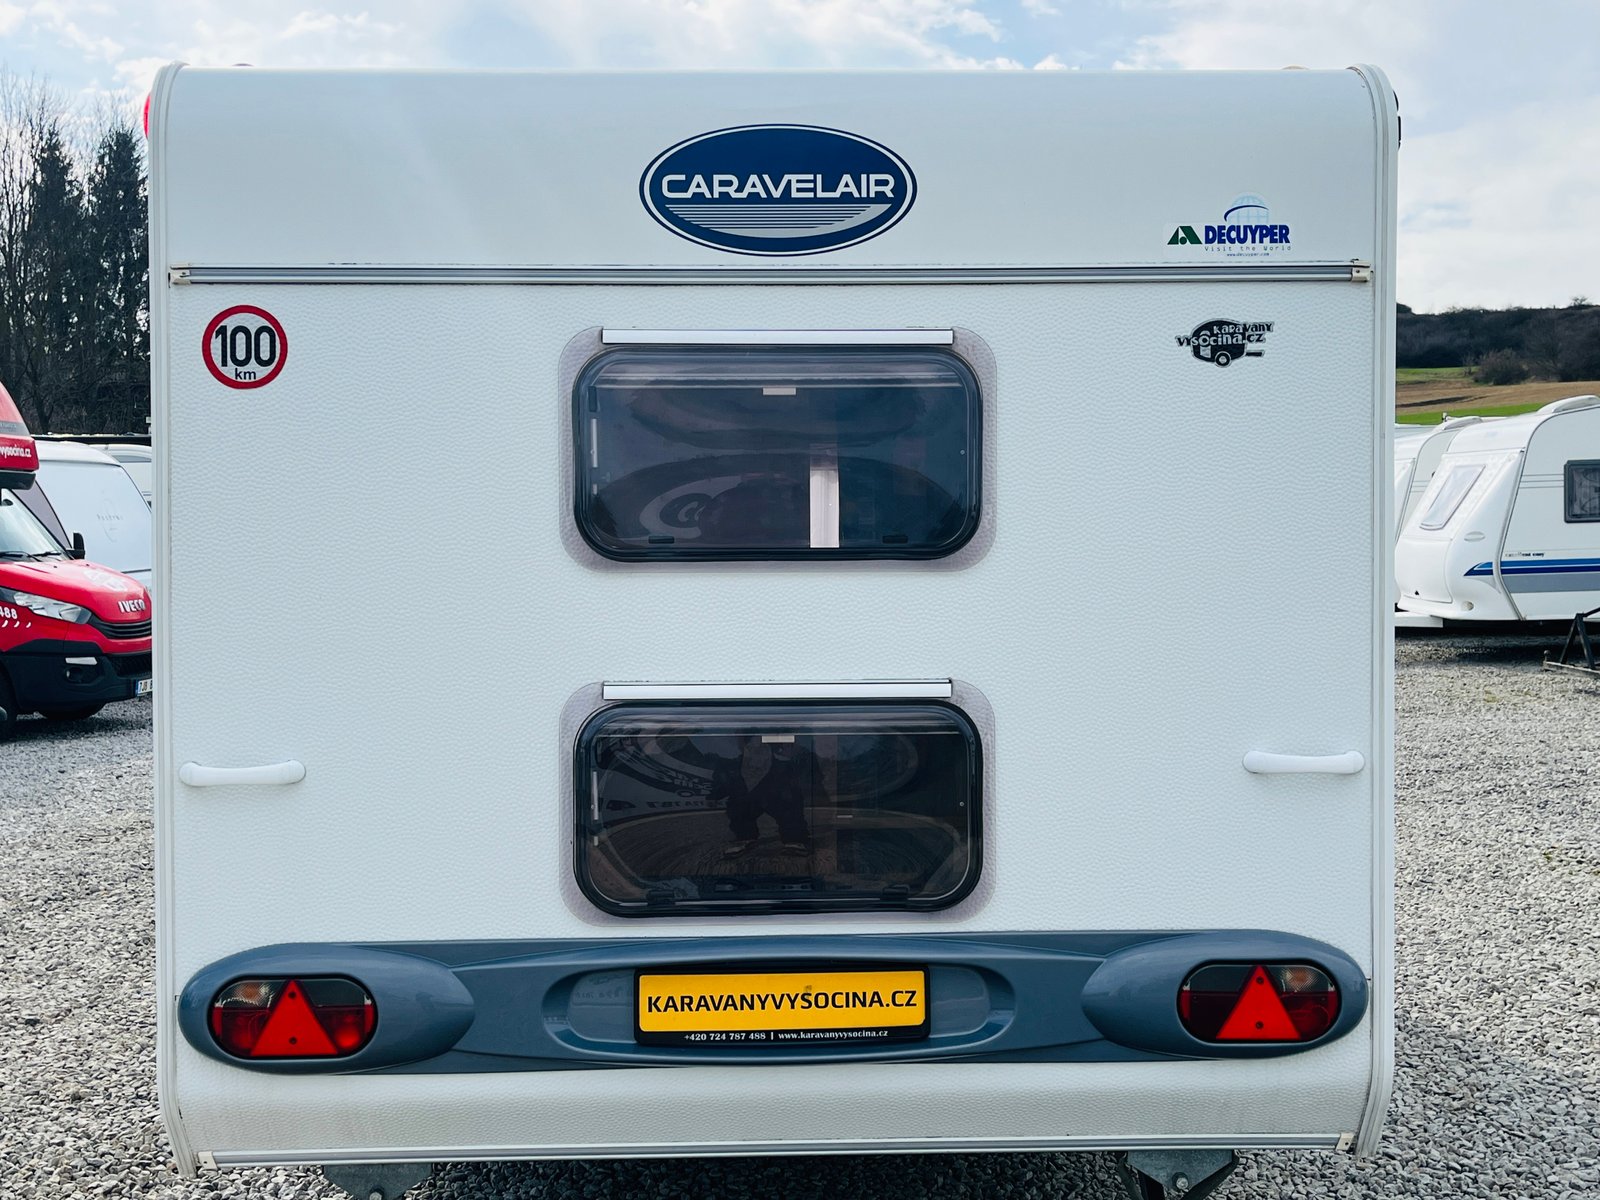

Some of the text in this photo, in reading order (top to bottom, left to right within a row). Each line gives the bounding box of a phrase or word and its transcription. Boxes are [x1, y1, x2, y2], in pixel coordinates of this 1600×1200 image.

[661, 173, 895, 198] CARAVELAIR
[1204, 225, 1290, 244] DECUYPER
[215, 325, 276, 367] 100
[234, 368, 257, 380] km
[118, 599, 146, 613] IVECO
[647, 990, 917, 1013] KARAVANYVYSOCINA.CZ
[684, 1030, 889, 1041] +420 724 787 488 www.karavanyvysocina.cz
